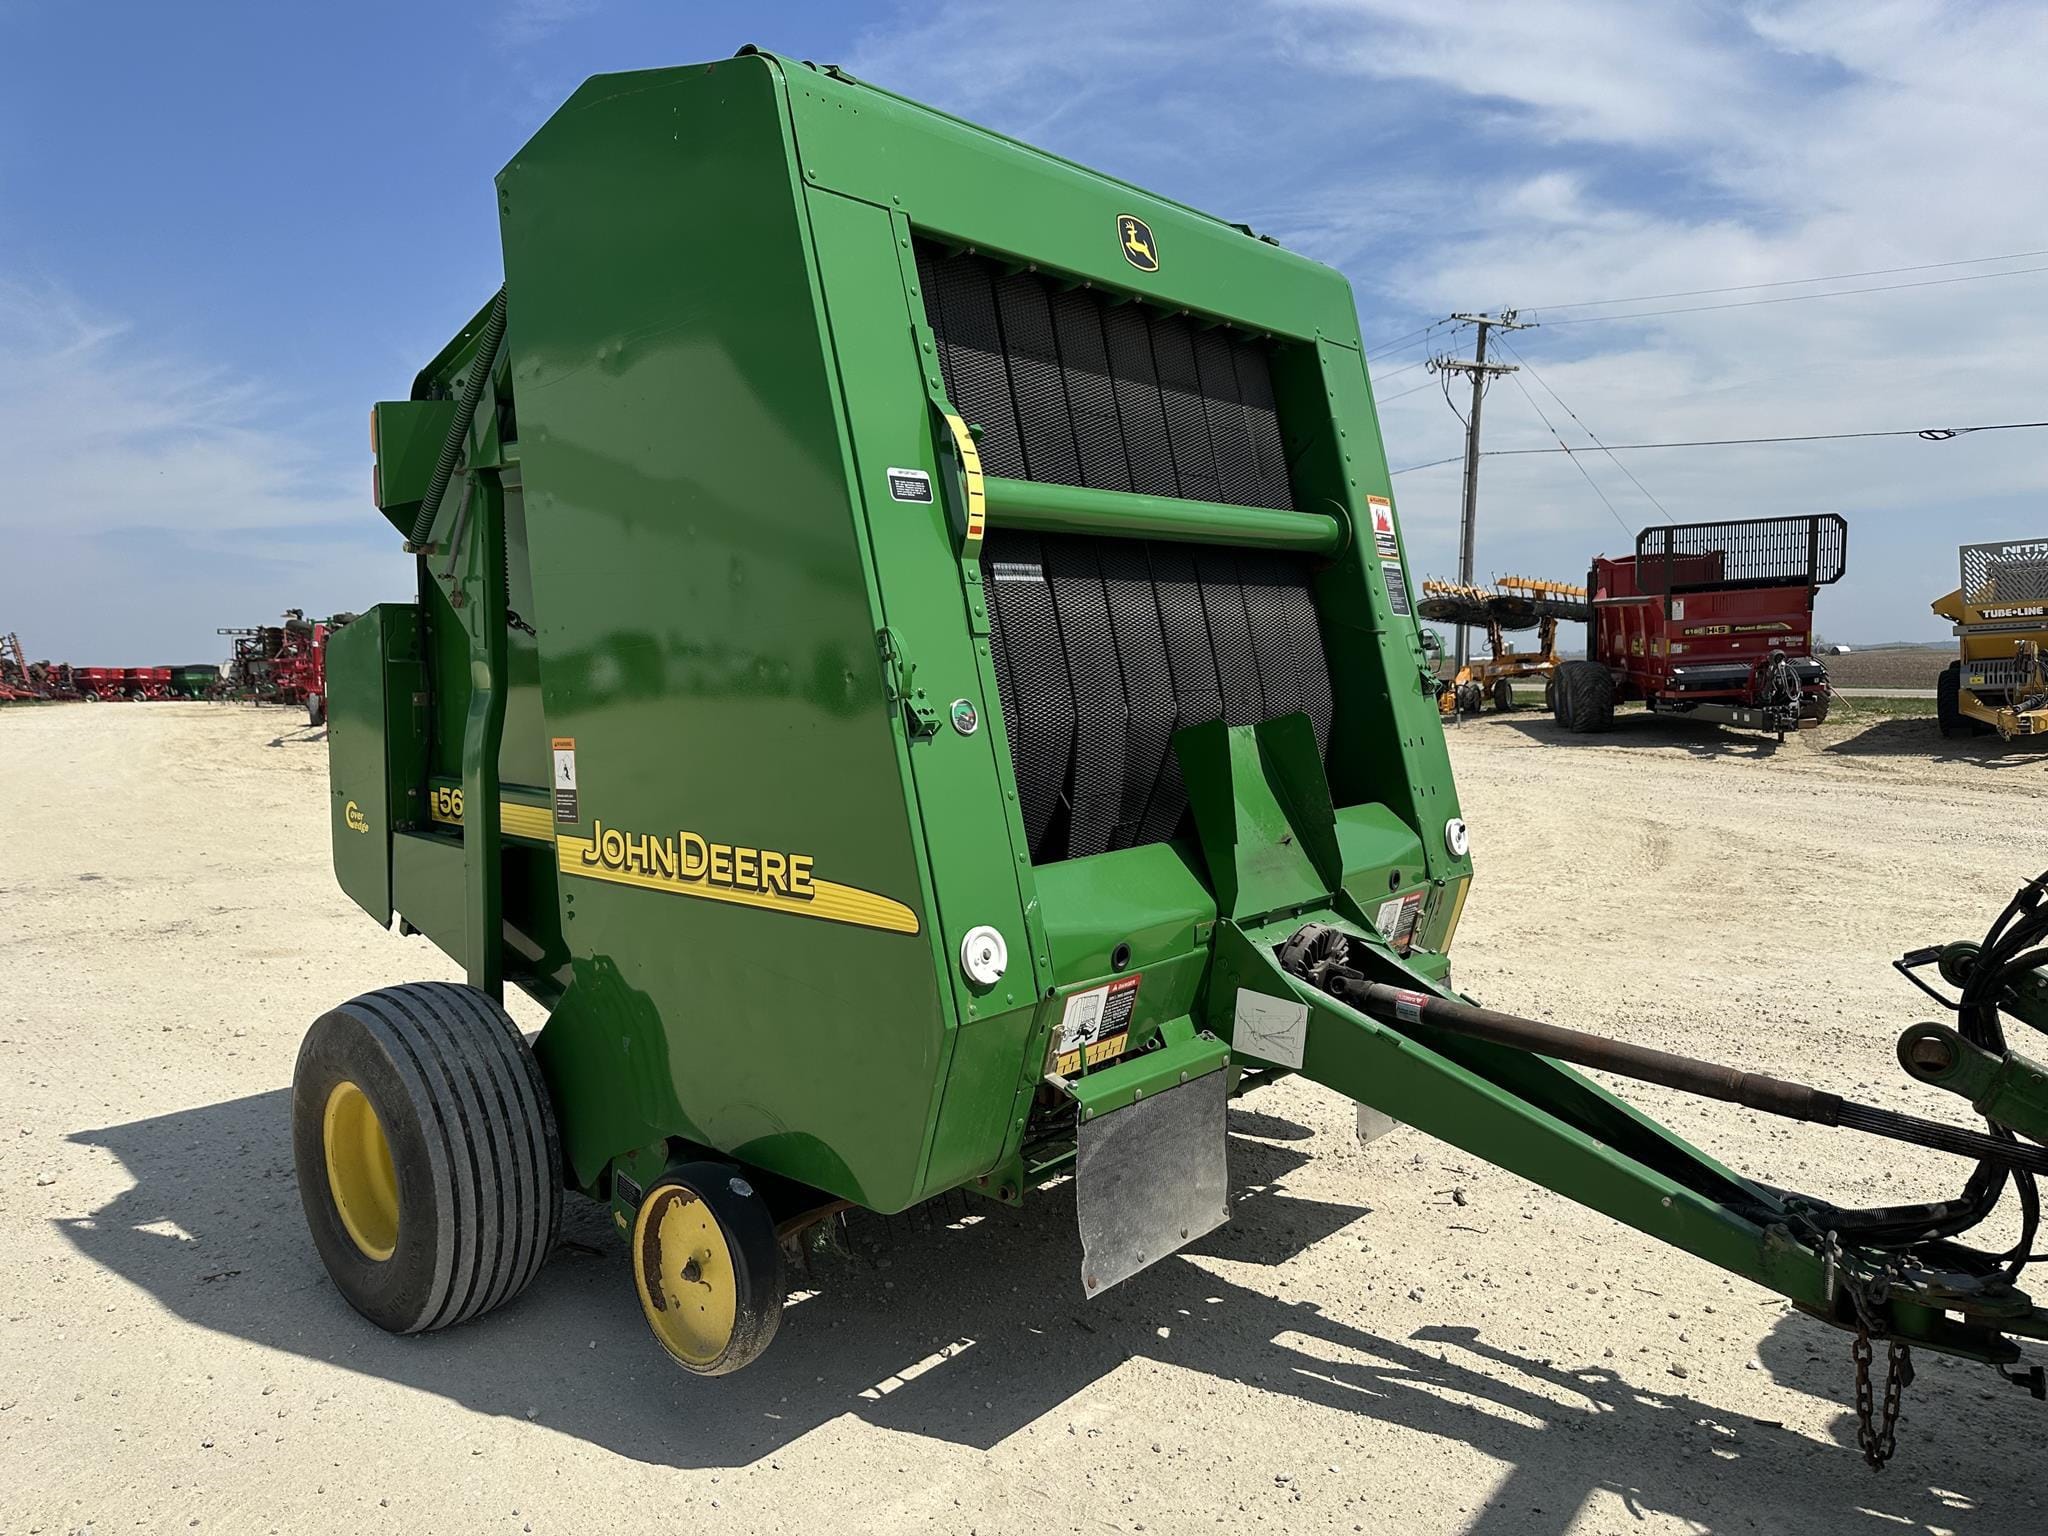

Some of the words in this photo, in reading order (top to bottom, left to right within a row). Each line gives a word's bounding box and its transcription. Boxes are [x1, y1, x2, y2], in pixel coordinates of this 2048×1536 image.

[2002, 543, 2048, 554] NITR
[439, 786, 464, 817] 56
[583, 819, 673, 877] JOHN
[679, 830, 815, 899] DEERE
